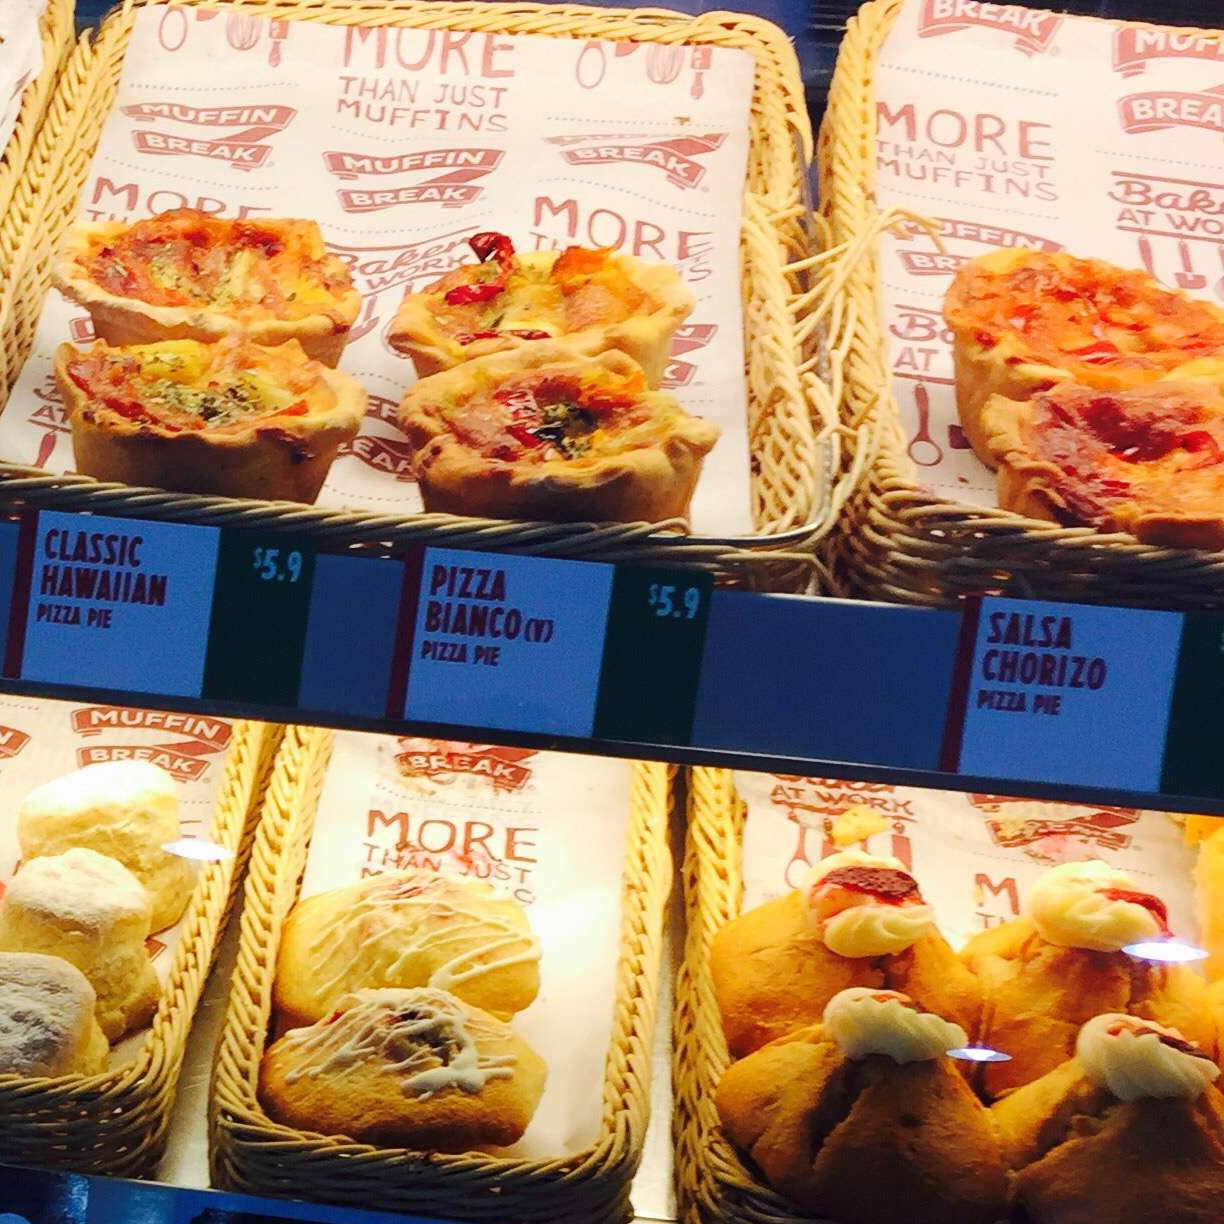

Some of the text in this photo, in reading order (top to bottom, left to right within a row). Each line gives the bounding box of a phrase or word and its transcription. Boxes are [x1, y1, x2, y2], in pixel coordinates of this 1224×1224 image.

[933, 0, 1043, 36] BREAK
[344, 24, 515, 78] MORE
[339, 76, 508, 109] THAN JUST
[140, 104, 278, 123] MUFFIN
[336, 99, 510, 133] MUFFINS
[144, 133, 257, 161] BREAK
[876, 102, 1055, 160] MORE
[342, 151, 486, 173] MUFFIN
[575, 148, 691, 177] BREAK
[875, 139, 1051, 179] THAN JUST
[875, 157, 1059, 202] MUFFINS
[349, 187, 468, 207] BREAK
[1108, 180, 1224, 214] Bak
[534, 196, 713, 260] MORE
[1117, 208, 1156, 225] AT
[366, 255, 469, 290] WORK
[894, 347, 940, 373] AT
[44, 528, 143, 568] CLASSIC
[253, 547, 303, 583] $5.9
[40, 564, 168, 606] HAWAIIAN
[430, 564, 506, 602] PIZZA
[36, 603, 113, 629] PIZZA PIE
[648, 584, 701, 619] $5.9
[425, 601, 522, 641] BIANCO
[987, 611, 1073, 650] SALSA
[421, 640, 500, 667] PIZZA PIE
[982, 649, 1108, 691] CHORIZO
[977, 689, 1062, 716] PIZZA PIE
[90, 709, 222, 740] MUFFIN
[89, 748, 194, 774] BREAK
[409, 755, 517, 782] BREAK
[771, 784, 806, 799] AT
[814, 790, 914, 815] WORK
[367, 809, 539, 864] MORE
[362, 842, 441, 873] THAN
